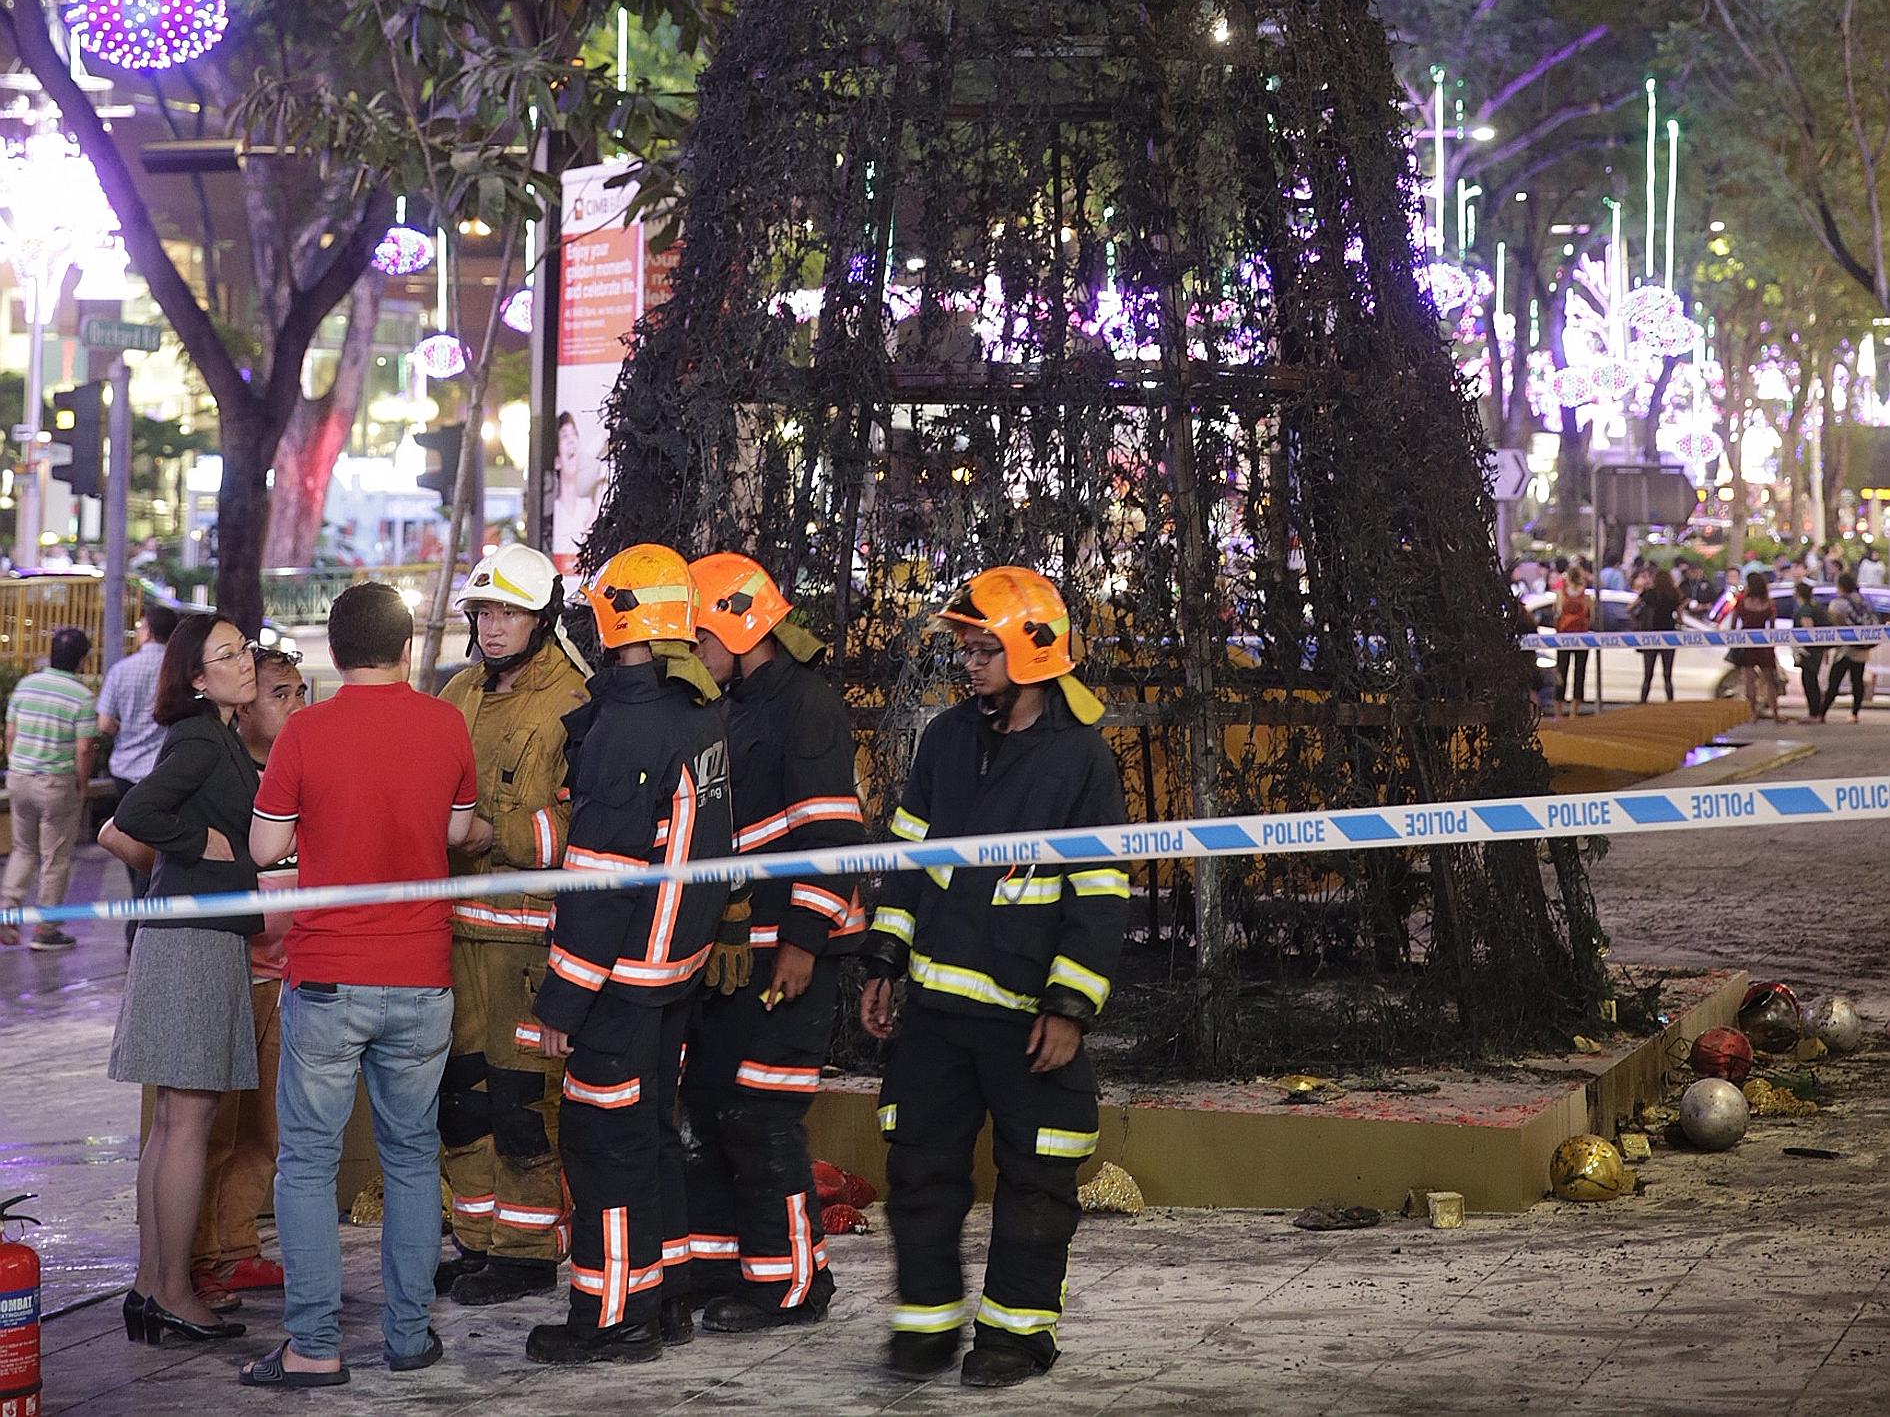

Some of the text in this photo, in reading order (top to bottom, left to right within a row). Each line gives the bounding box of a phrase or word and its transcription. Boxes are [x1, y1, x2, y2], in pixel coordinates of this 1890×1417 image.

[586, 197, 608, 216] CIMB
[1600, 636, 1619, 646] POLICE
[1683, 634, 1703, 645] POLICE
[1770, 631, 1790, 643] POLICE
[1860, 628, 1882, 641] POLICE
[978, 842, 1041, 865] POLICE
[1121, 829, 1183, 854] POLICE
[1262, 819, 1326, 845] POLICE
[1405, 810, 1468, 837] POLICE
[1548, 801, 1612, 828] POLICE
[1692, 792, 1755, 820] POLICE
[1836, 784, 1890, 811] POLIC
[0, 1296, 33, 1313] OMBAT
